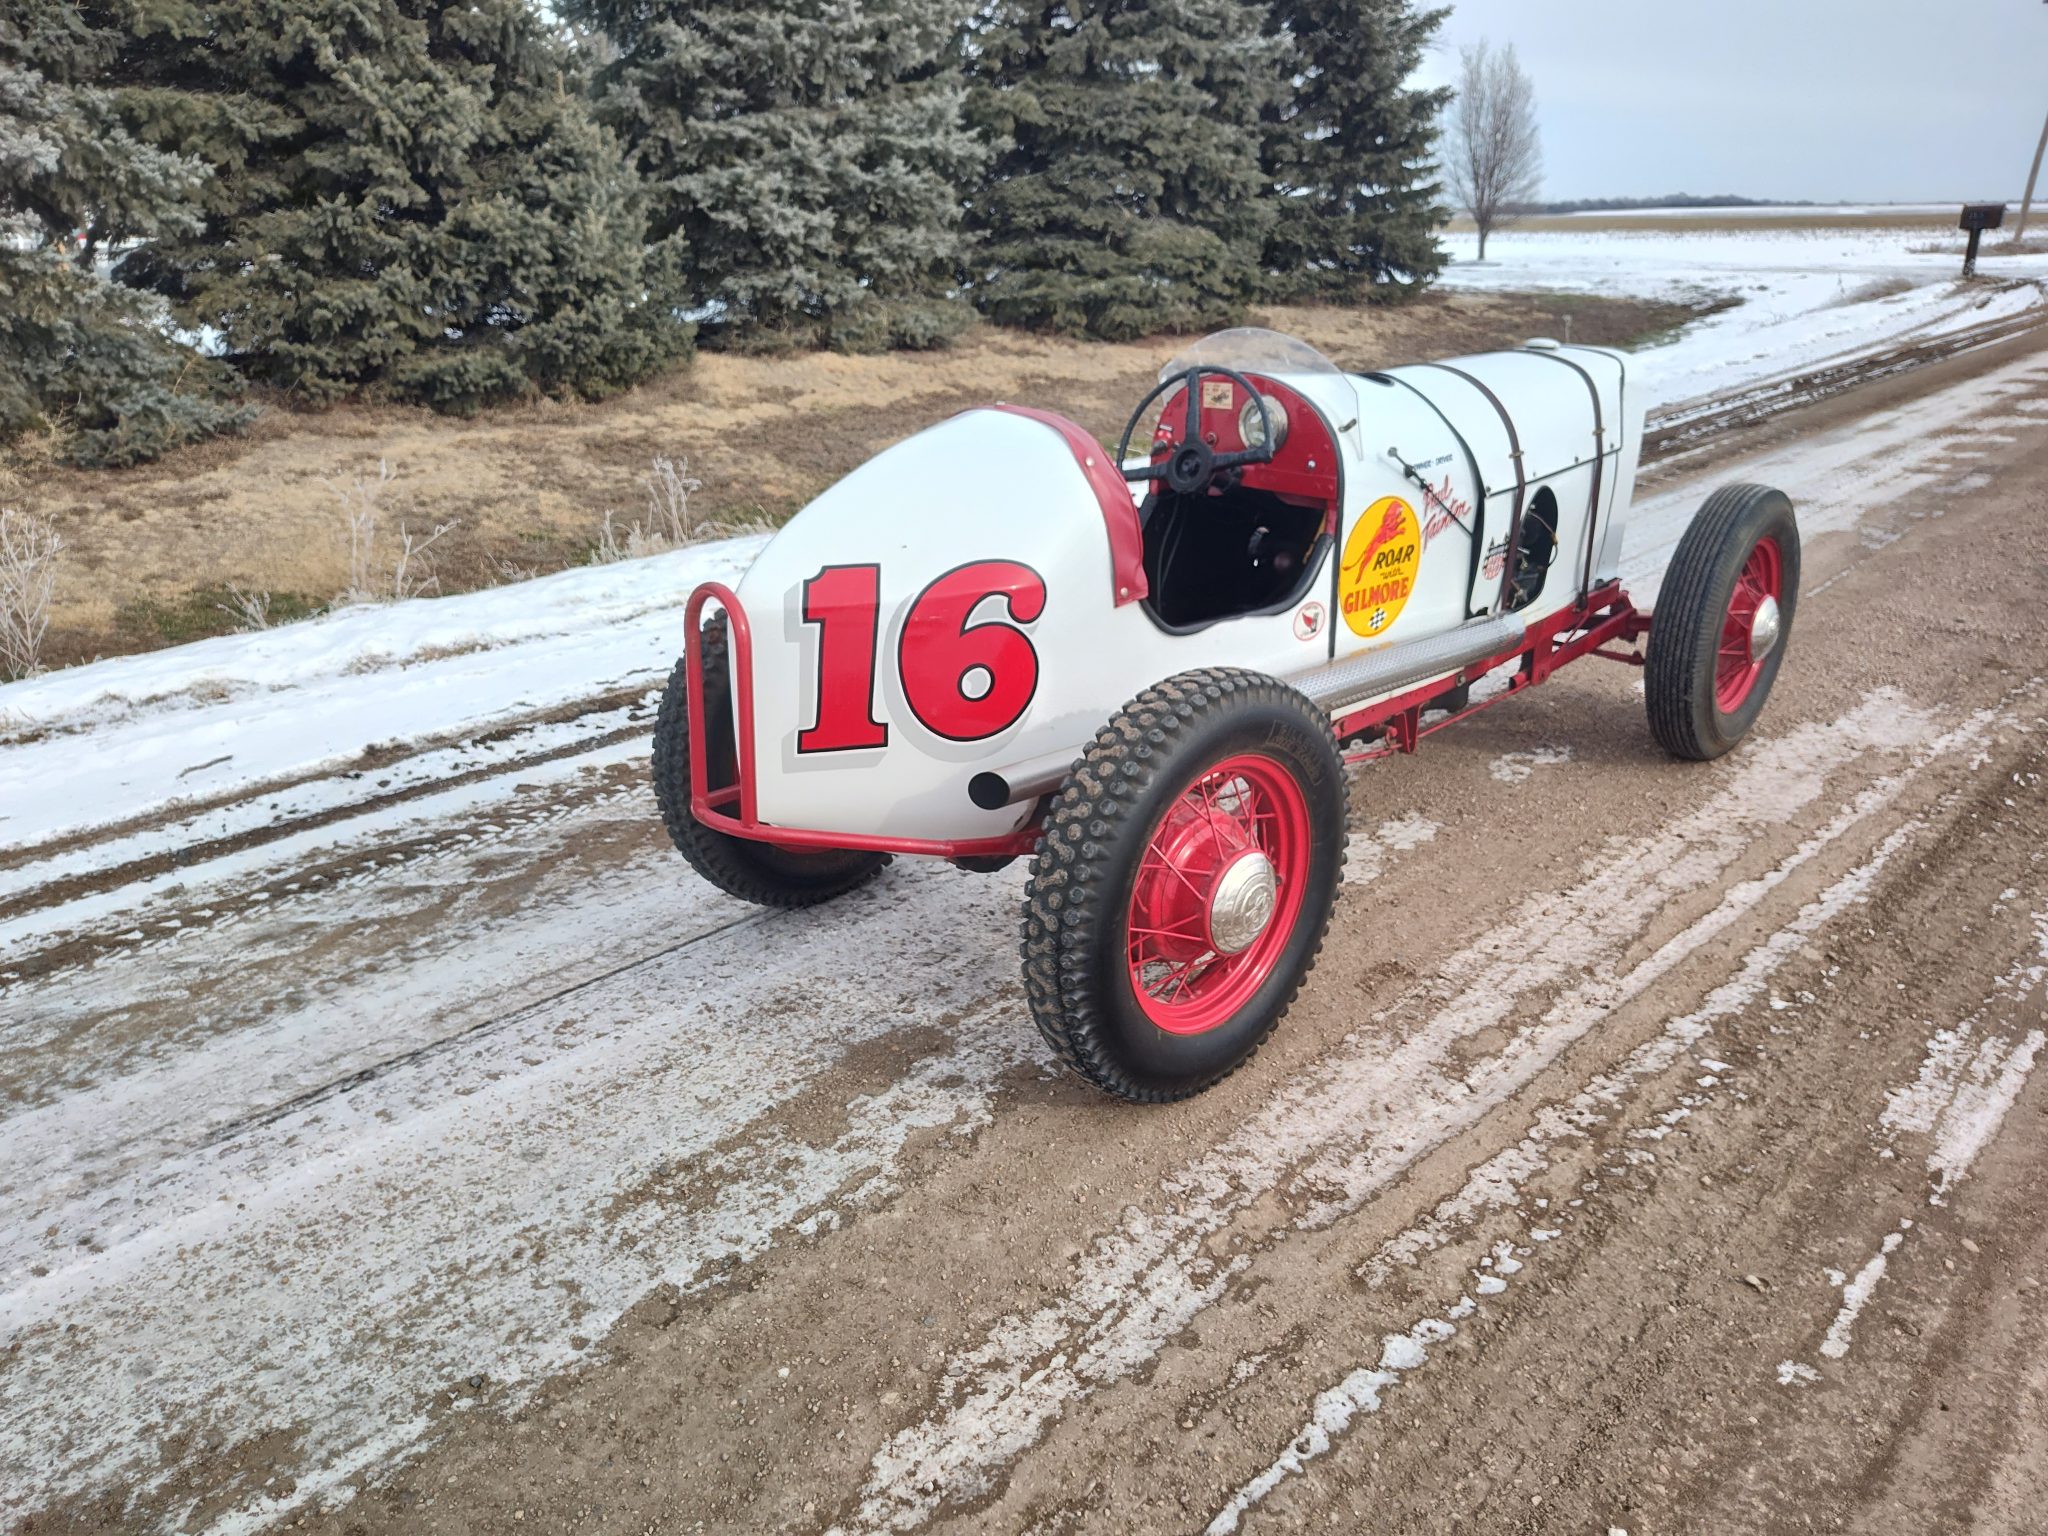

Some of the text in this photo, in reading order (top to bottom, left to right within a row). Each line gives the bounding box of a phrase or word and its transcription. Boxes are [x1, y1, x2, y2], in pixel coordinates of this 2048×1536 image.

[1372, 544, 1415, 571] ROAR
[1344, 577, 1409, 615] GILMORE
[796, 559, 1047, 755] 16
